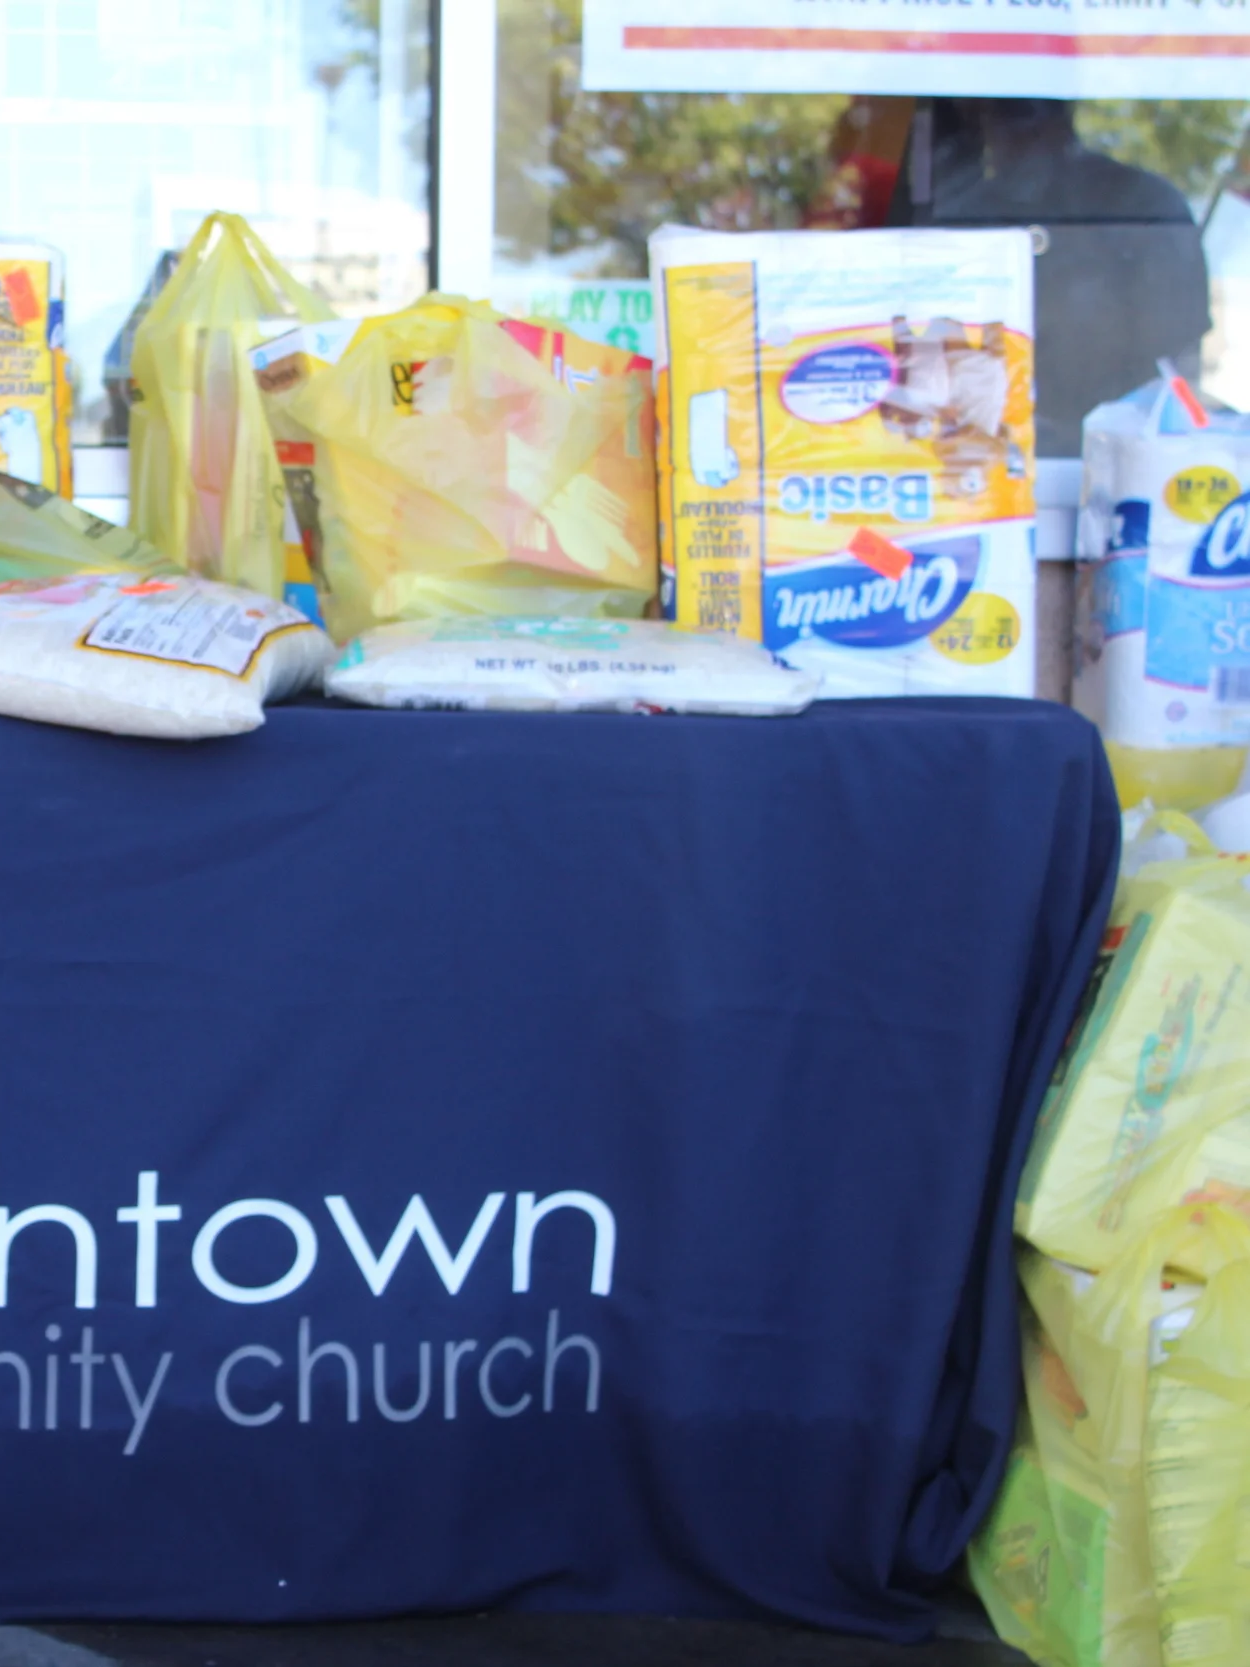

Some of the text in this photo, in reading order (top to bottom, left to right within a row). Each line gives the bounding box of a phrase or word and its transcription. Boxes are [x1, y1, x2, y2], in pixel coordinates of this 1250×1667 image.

[780, 473, 933, 522] Basic
[774, 556, 959, 639] Charmin
[474, 657, 506, 671] NET
[511, 657, 536, 670] WT
[215, 1308, 601, 1427] church
